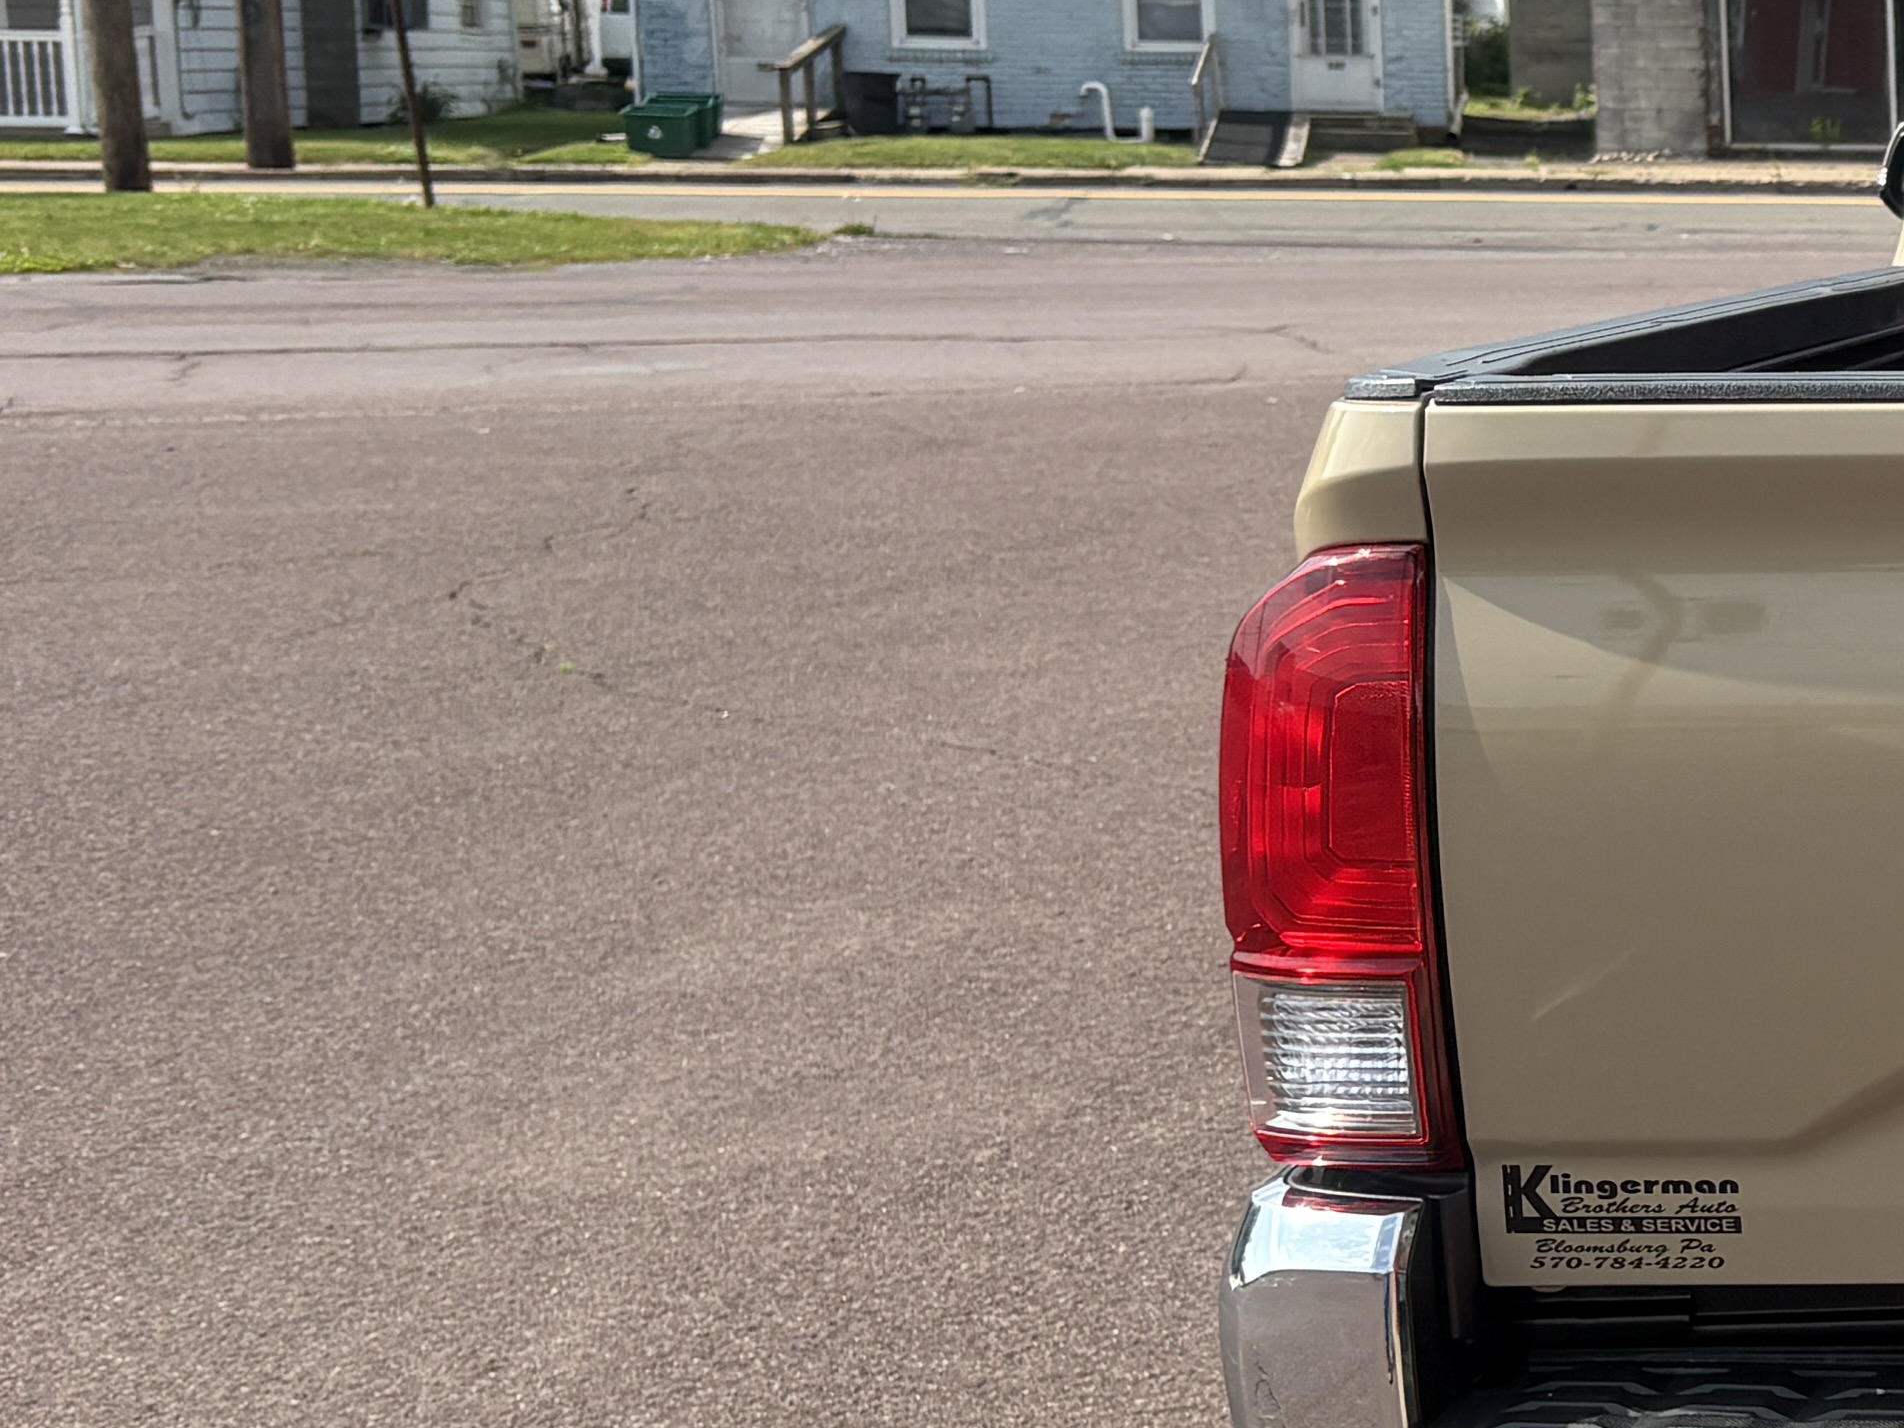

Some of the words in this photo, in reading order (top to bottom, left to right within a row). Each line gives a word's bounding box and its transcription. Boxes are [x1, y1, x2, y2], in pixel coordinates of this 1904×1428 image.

[1502, 1164, 1740, 1234] Klingerman
[1561, 1196, 1666, 1214] Brothers
[1674, 1196, 1740, 1214] Auto
[1543, 1218, 1615, 1232] SALES
[1621, 1218, 1637, 1232] &
[1641, 1218, 1737, 1232] SERVICE
[1534, 1238, 1671, 1258] Bloomsburg
[1679, 1238, 1717, 1254] Pa
[1530, 1256, 1726, 1270] 570-784-4220
